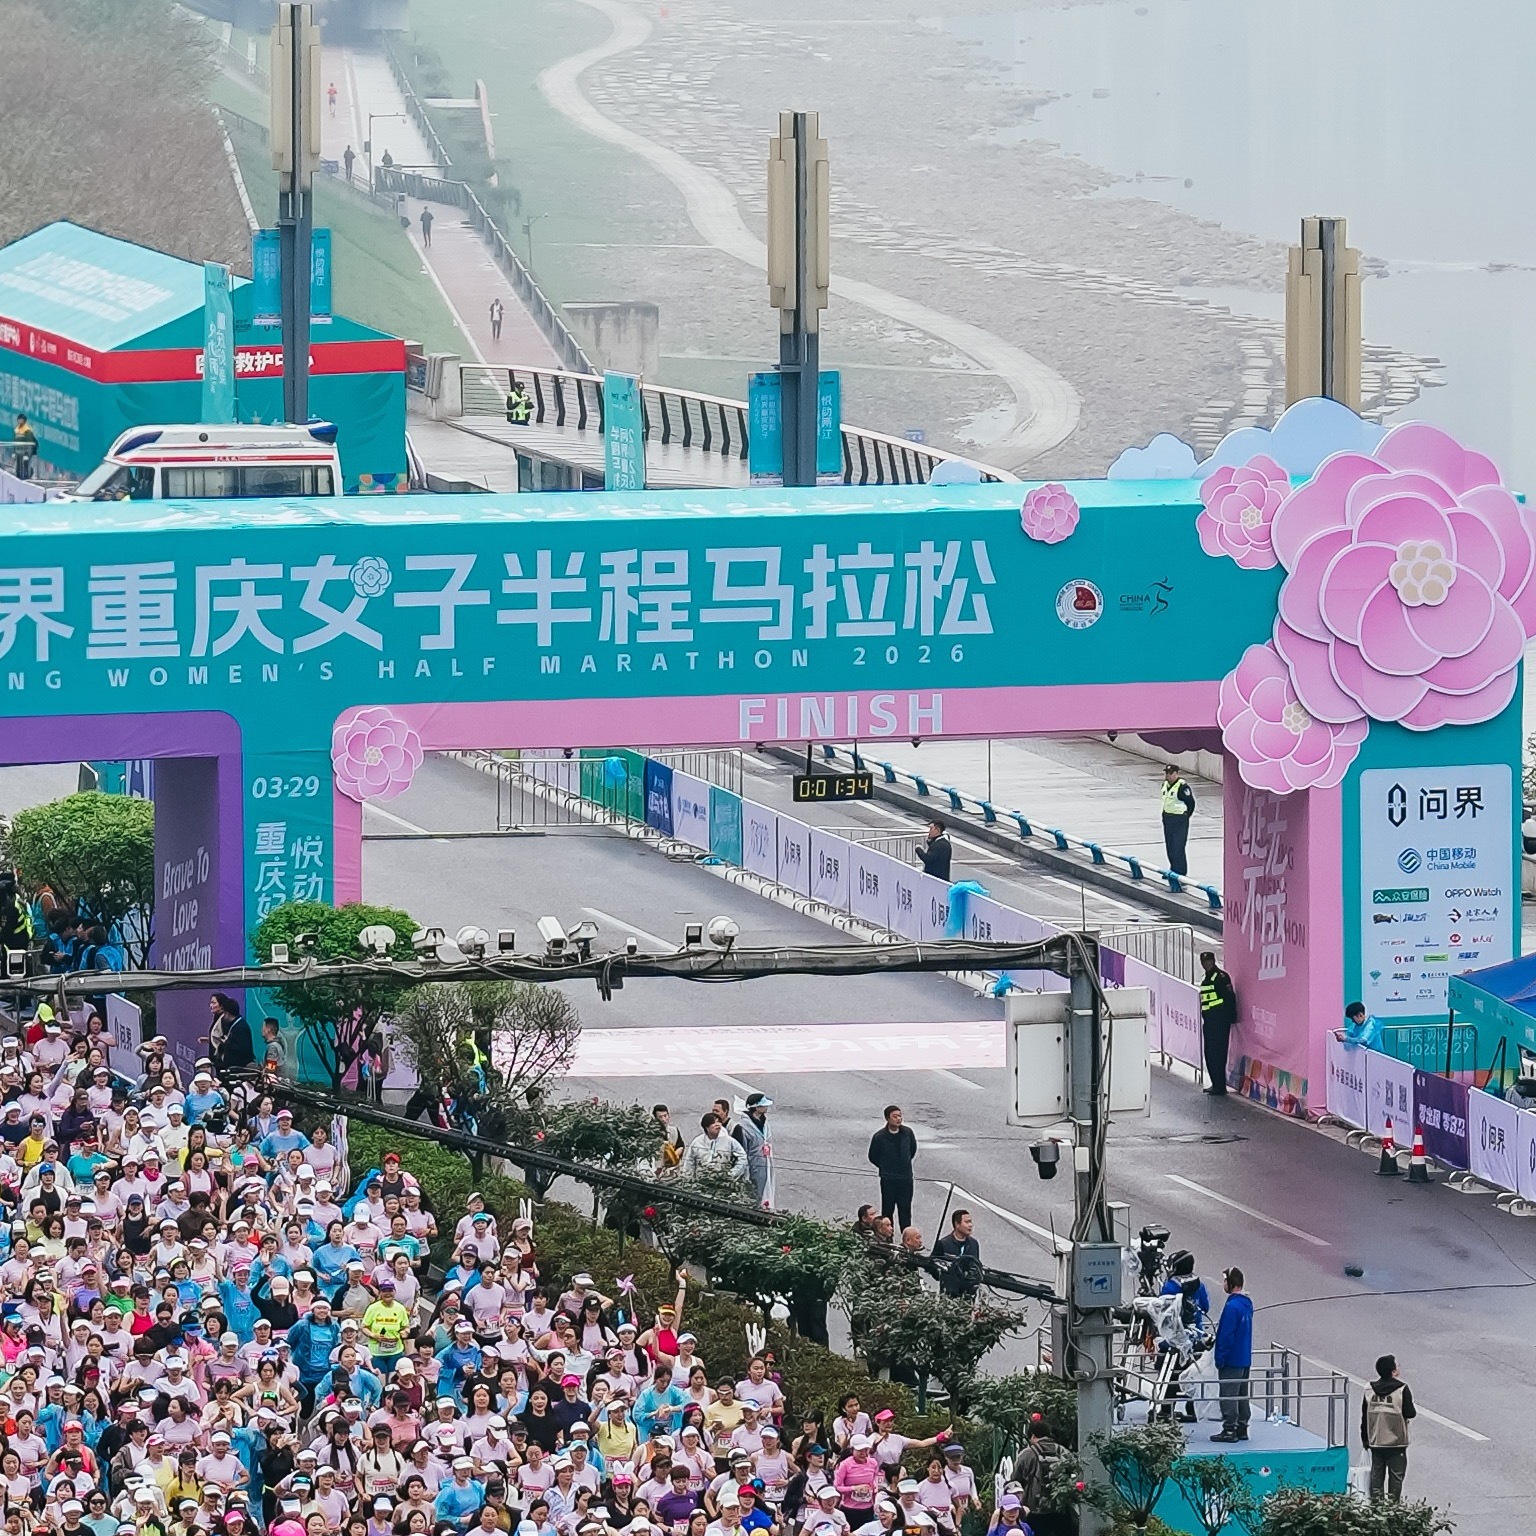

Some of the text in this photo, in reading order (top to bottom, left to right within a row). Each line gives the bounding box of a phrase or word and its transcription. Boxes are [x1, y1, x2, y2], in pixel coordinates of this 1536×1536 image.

[1120, 594, 1150, 603] CHINA
[107, 661, 335, 688] WOMEN'S
[378, 657, 498, 679] HALF
[540, 649, 810, 675] MARATHON
[853, 644, 965, 667] 2026
[739, 693, 943, 740] FINISH
[1420, 787, 1484, 820] 问界
[1427, 848, 1476, 860] 中国移动
[163, 846, 210, 899] Brave To
[865, 868, 879, 898] 问界
[1392, 890, 1427, 901] 众安保险
[1445, 888, 1501, 898] OPPO Watch
[172, 899, 198, 938] Love
[1488, 1123, 1505, 1156] 问界
